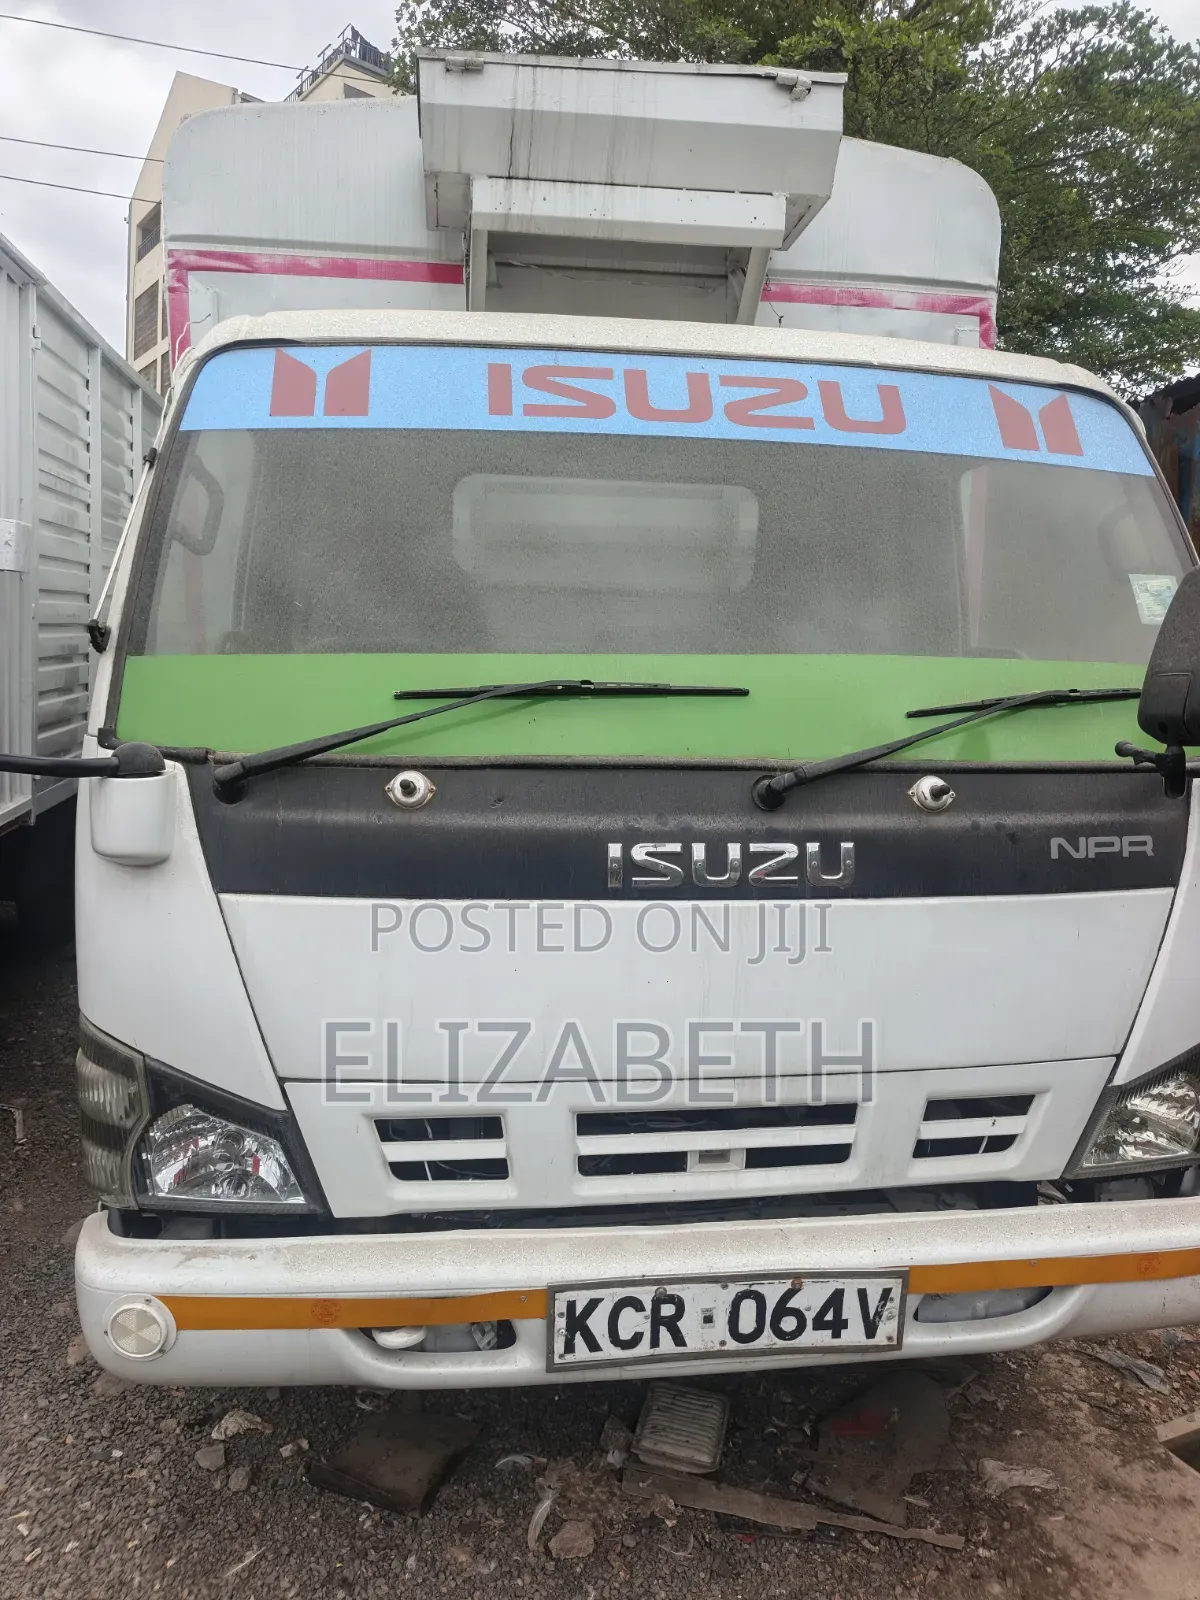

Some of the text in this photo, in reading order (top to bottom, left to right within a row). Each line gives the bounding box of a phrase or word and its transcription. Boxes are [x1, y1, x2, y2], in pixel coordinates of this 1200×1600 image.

[487, 362, 907, 435] ISUZU
[607, 841, 856, 888] ISUZU
[1050, 835, 1155, 860] NPR
[563, 1286, 893, 1355] KCR 064V
